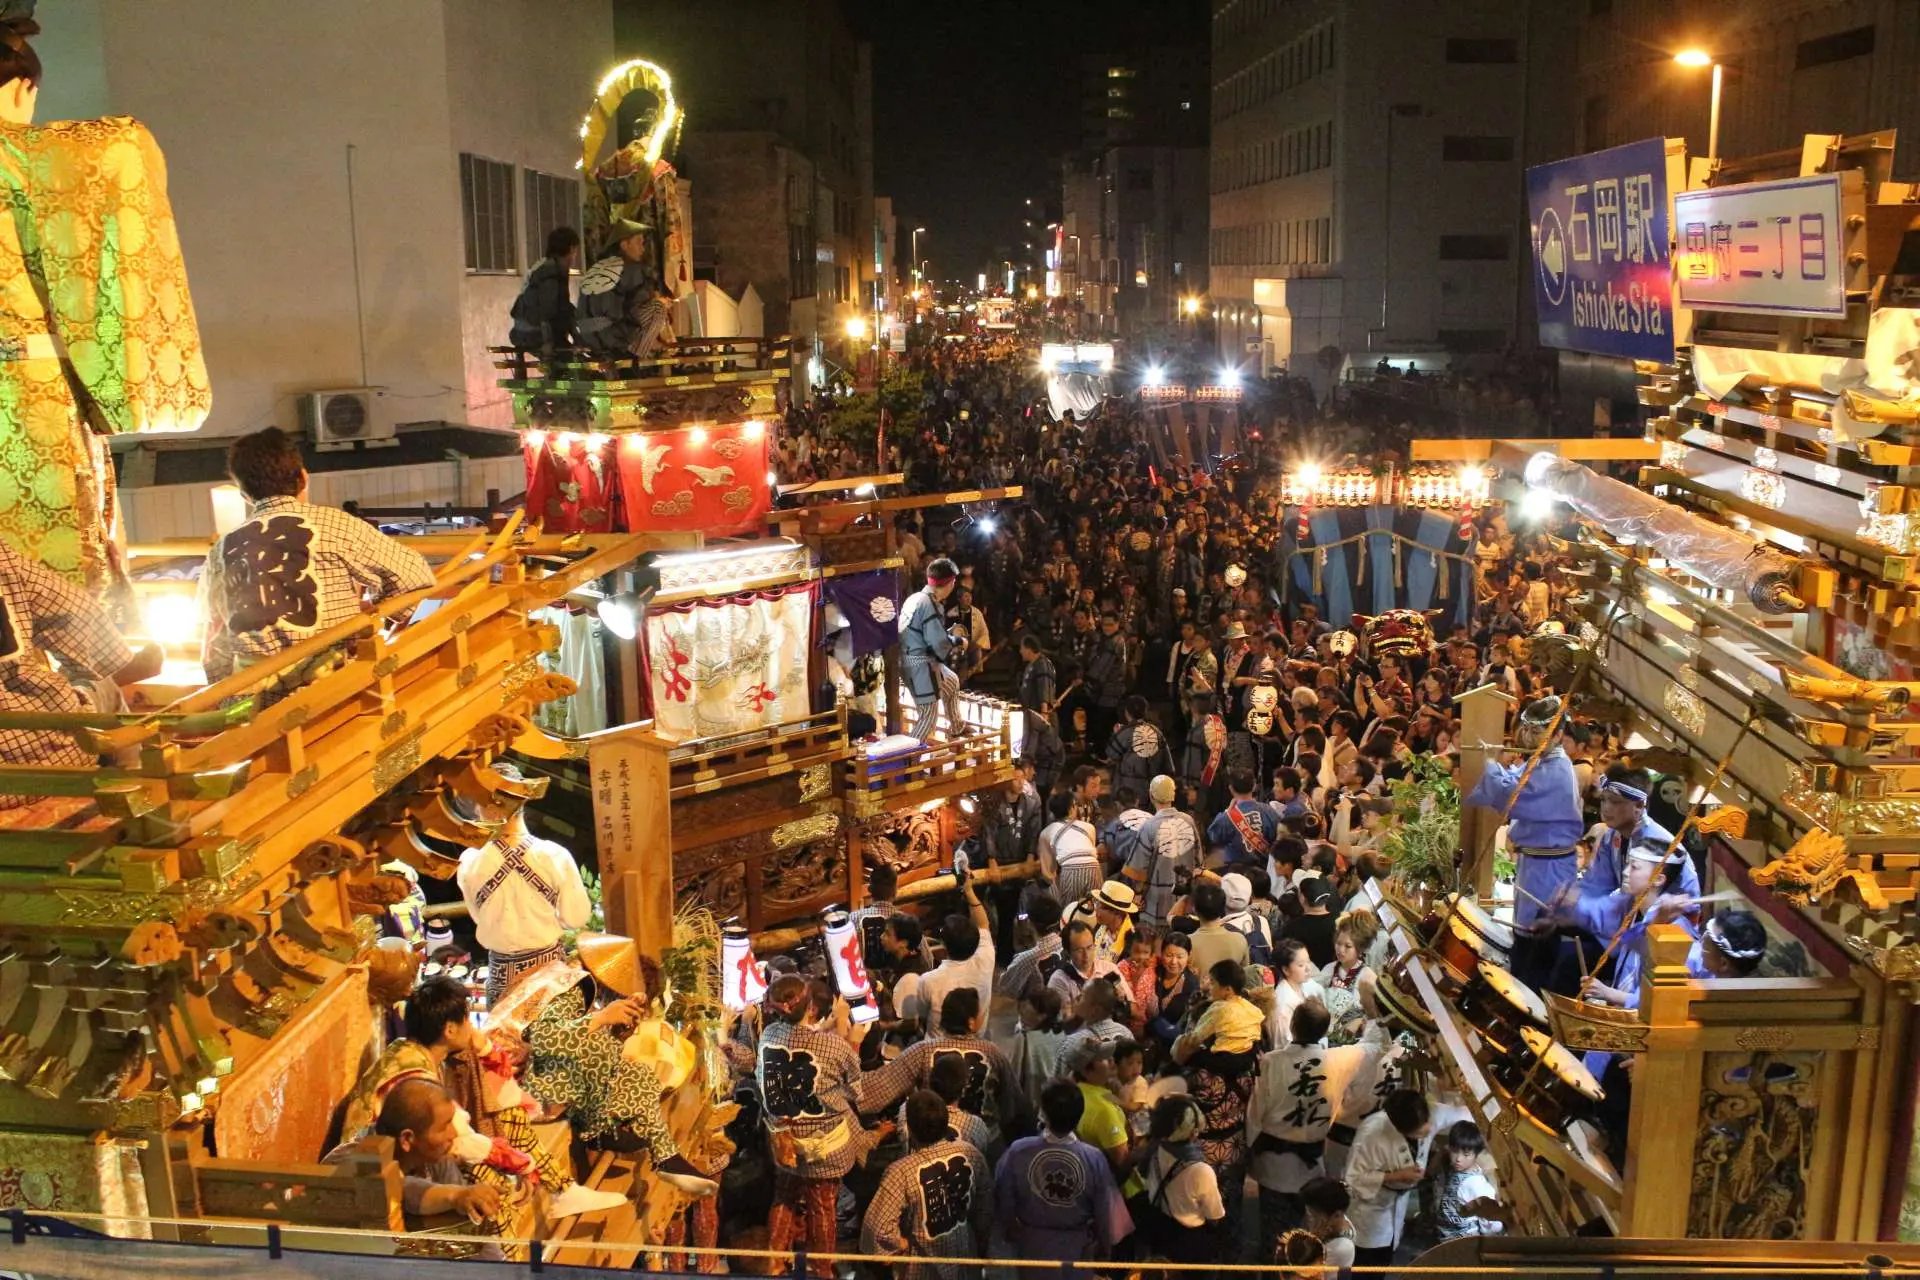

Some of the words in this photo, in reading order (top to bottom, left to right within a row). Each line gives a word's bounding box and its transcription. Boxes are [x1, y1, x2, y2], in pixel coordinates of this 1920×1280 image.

[1565, 173, 1659, 265] 石岡駅
[1572, 280, 1629, 332] Ishioka
[1629, 282, 1665, 336] Sta.
